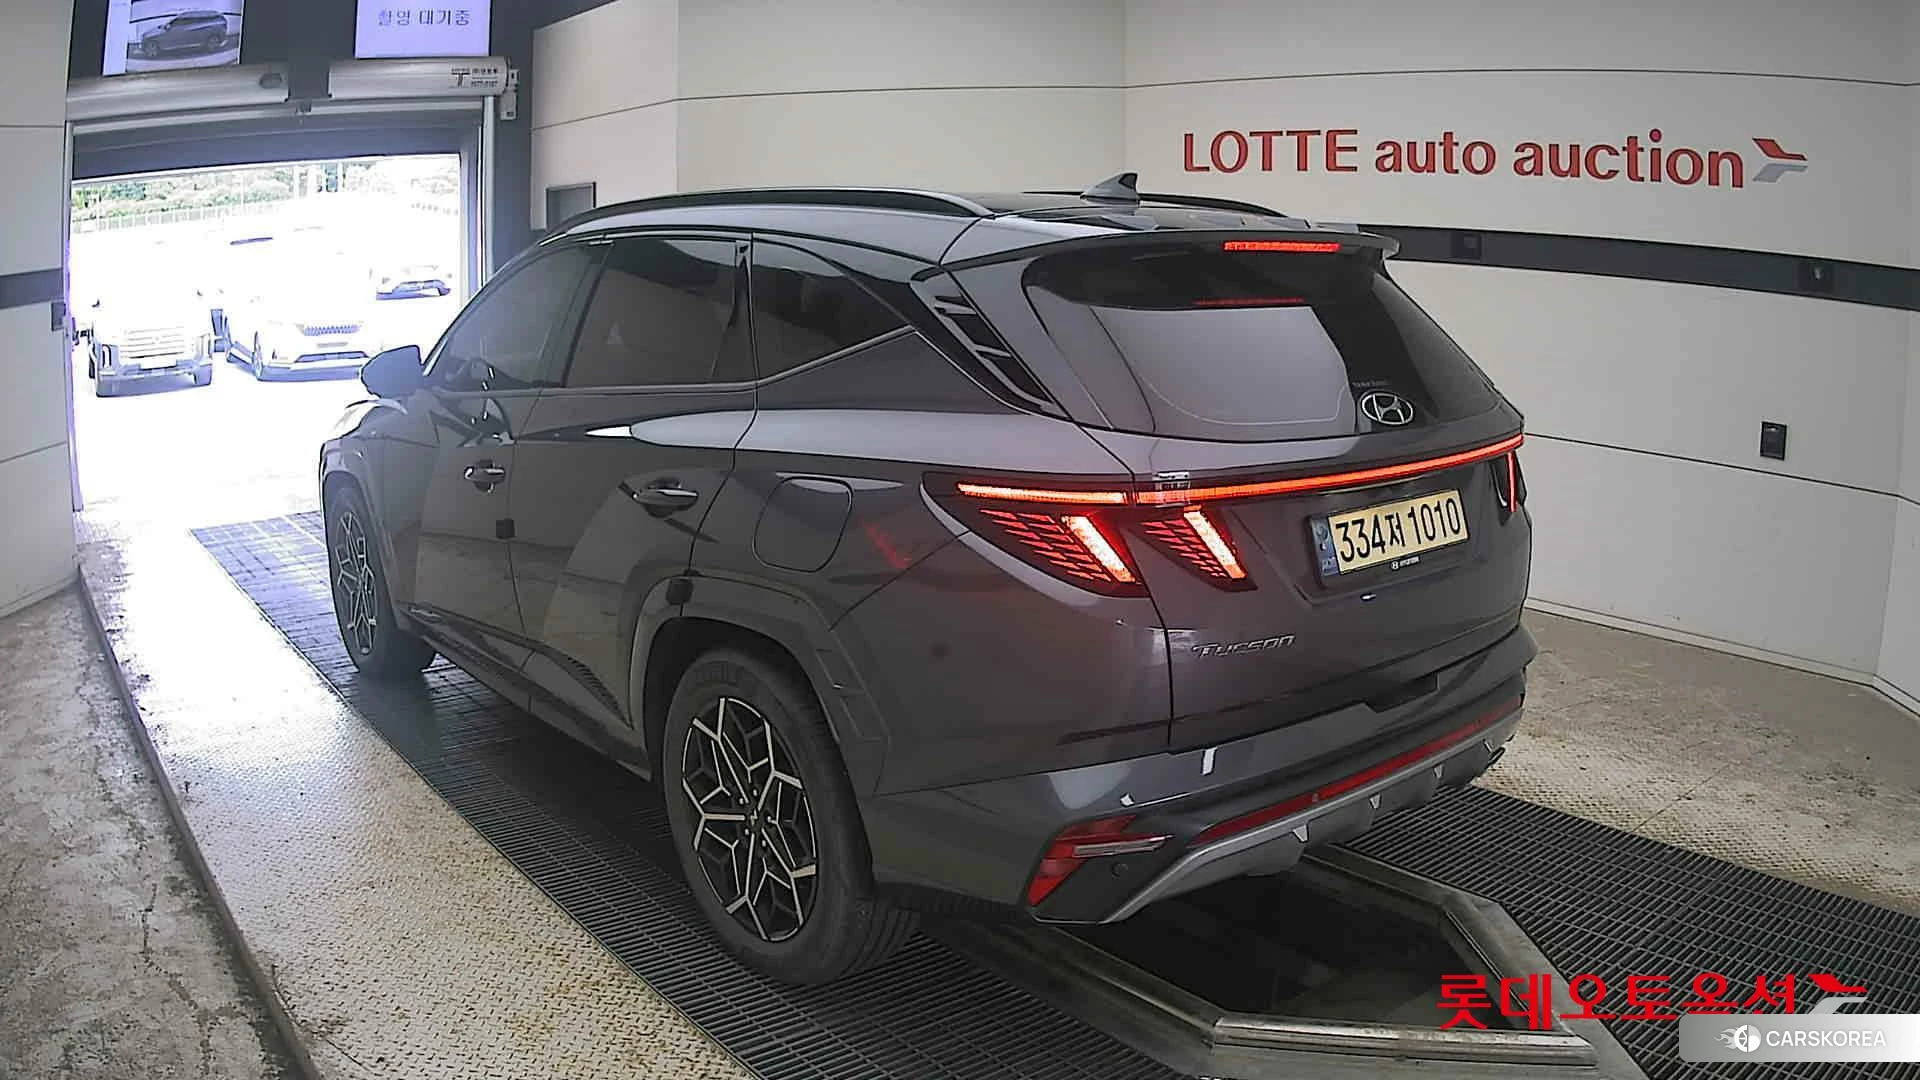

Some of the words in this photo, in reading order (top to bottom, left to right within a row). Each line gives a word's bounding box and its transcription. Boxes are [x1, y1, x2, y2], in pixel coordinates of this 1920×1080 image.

[419, 9, 470, 26] 대기중
[1183, 129, 1359, 173] LOTTE
[1375, 131, 1497, 175] auto
[1513, 129, 1744, 188] auction
[1335, 512, 1406, 562] 334저
[1408, 498, 1461, 545] 1010
